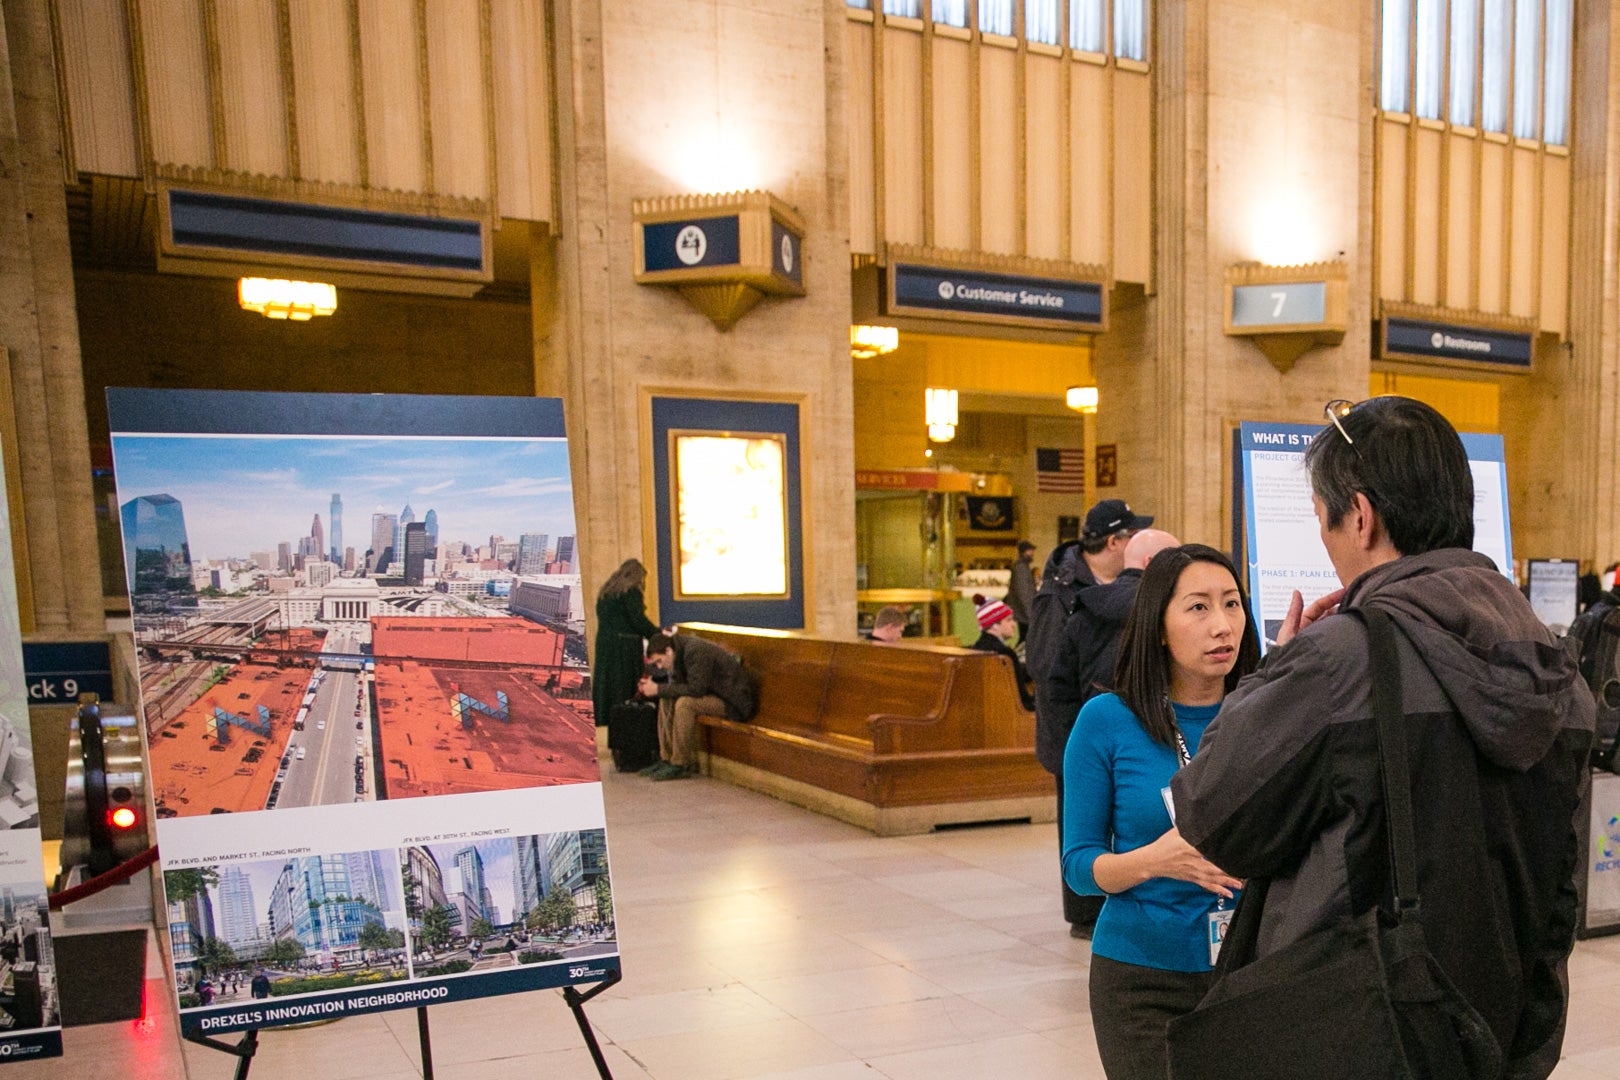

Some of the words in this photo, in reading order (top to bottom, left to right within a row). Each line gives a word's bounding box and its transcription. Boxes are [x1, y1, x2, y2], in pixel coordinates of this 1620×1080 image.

[956, 285, 1017, 303] Customer
[1019, 291, 1065, 308] Service
[1271, 292, 1287, 318] 7
[1252, 432, 1285, 444] WHAT
[1288, 434, 1299, 445] IS
[1254, 453, 1288, 462] PROJECT
[1261, 569, 1287, 577] PHASE
[63, 679, 78, 698] 9
[262, 849, 286, 857] FACING
[201, 1012, 262, 1030] DREXEL'S
[266, 999, 345, 1021] INNOVATION
[348, 986, 449, 1010] NEIGHBORHOOD
